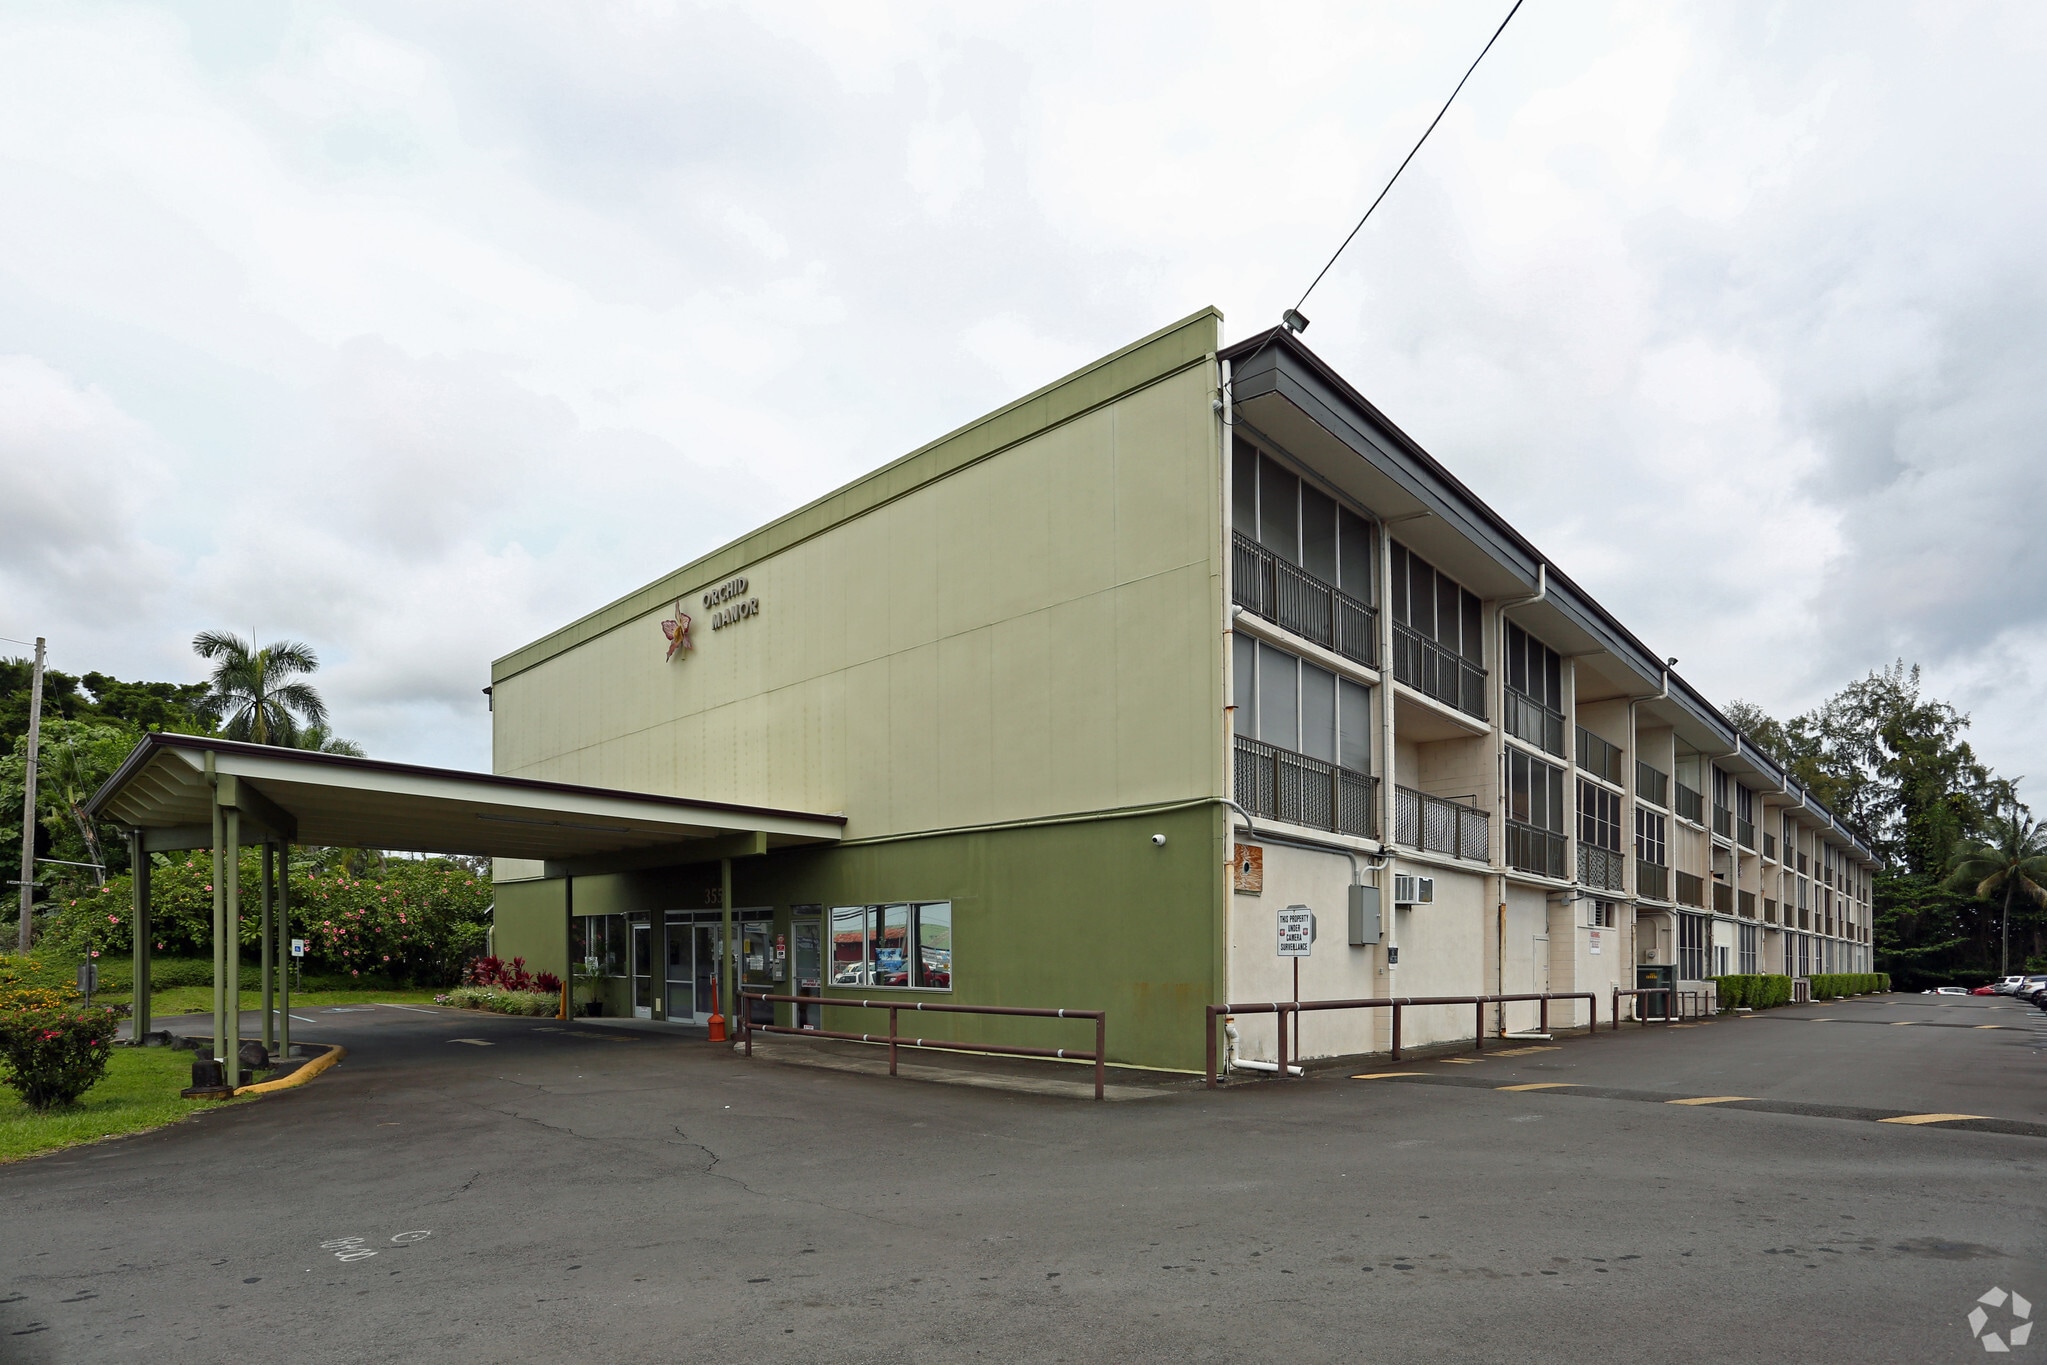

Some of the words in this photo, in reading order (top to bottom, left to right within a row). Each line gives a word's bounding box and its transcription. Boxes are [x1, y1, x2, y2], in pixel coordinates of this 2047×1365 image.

[703, 576, 749, 609] ORCHID
[711, 597, 759, 631] MANOR
[1280, 915, 1289, 923] THIS
[1290, 914, 1309, 923] PROPERTY
[1286, 934, 1302, 942] CAMERA
[1280, 943, 1308, 951] SURVEILLANCE
